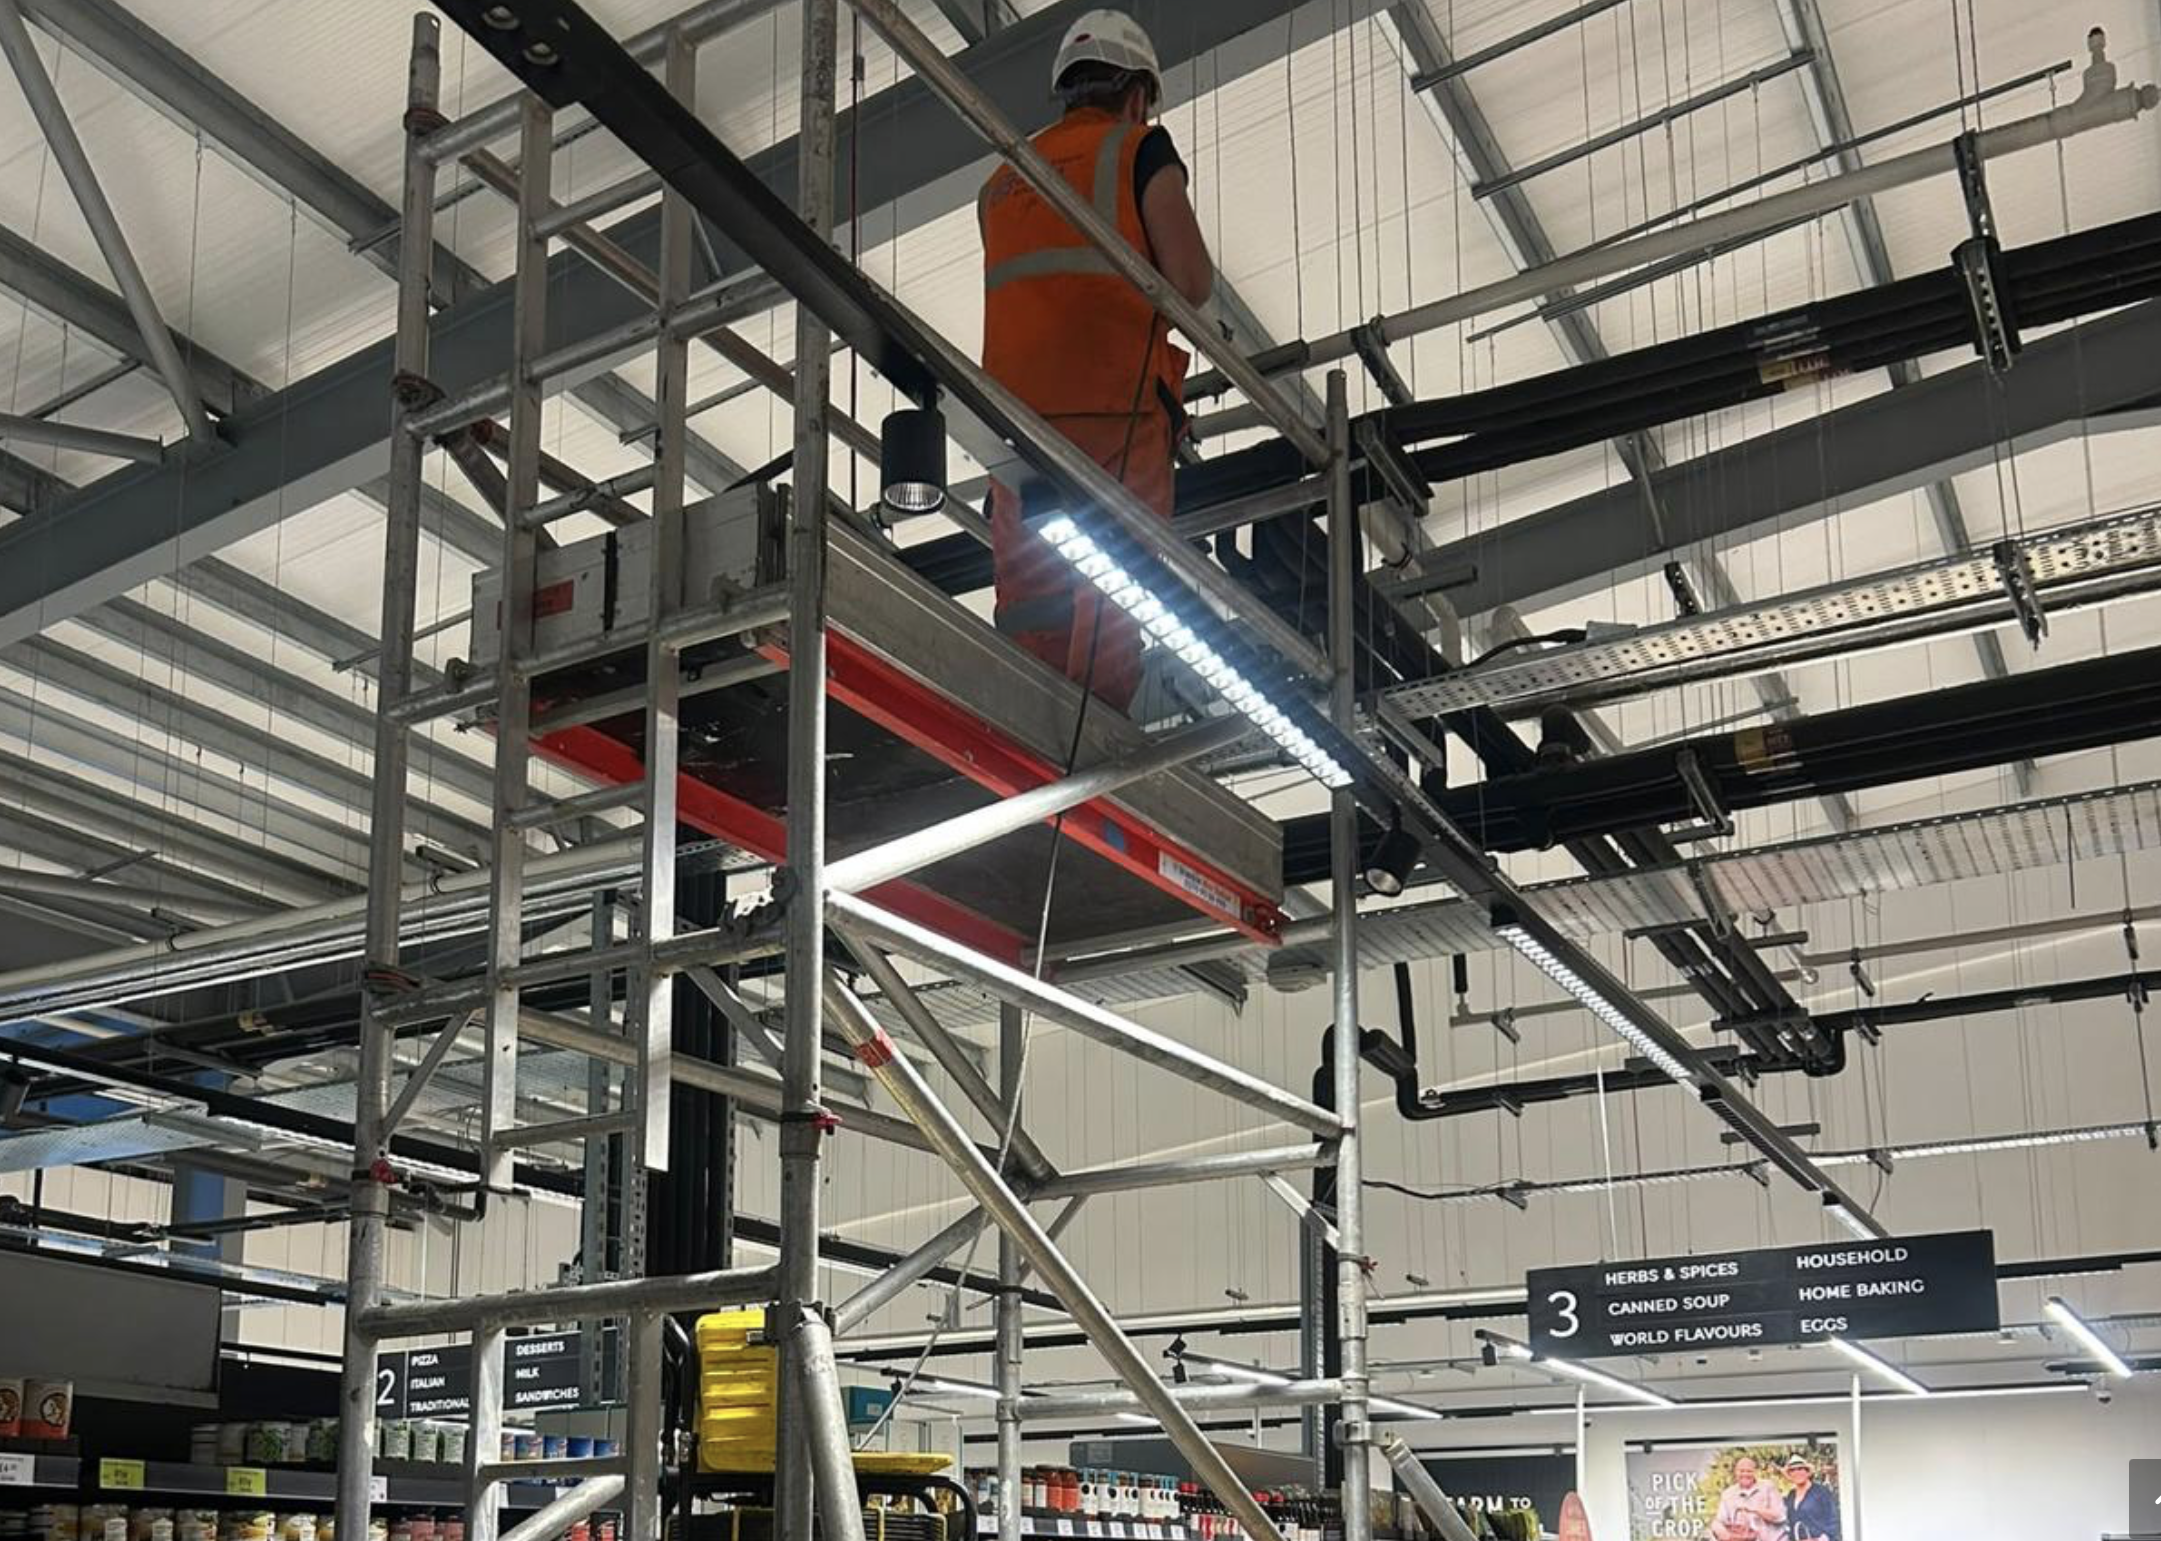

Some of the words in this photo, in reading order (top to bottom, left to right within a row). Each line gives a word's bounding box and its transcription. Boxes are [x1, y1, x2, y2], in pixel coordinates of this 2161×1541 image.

[1796, 1247, 1909, 1269] HOUSEHOLD
[1605, 1268, 1660, 1286] HERBS
[1663, 1267, 1676, 1281] &
[1679, 1261, 1739, 1280] SPICES
[1798, 1284, 1851, 1301] HOME
[1856, 1278, 1925, 1298] BAKING
[1547, 1290, 1579, 1338] 3
[1607, 1298, 1678, 1316] CANNED
[1682, 1293, 1731, 1311] SOUP
[1801, 1316, 1848, 1333] EGGS
[1609, 1330, 1669, 1347] WORLD
[1674, 1323, 1763, 1343] FLAVOURS
[516, 1341, 565, 1356] DESSERTS
[411, 1353, 439, 1367] PIZZA
[410, 1376, 445, 1389] ITALIAN
[515, 1367, 540, 1379] MILK
[377, 1368, 396, 1406] 2
[515, 1387, 579, 1403] SANDWICHES
[410, 1398, 470, 1412] TRADITIONAL
[1652, 1472, 1698, 1492] PICK
[1509, 1496, 1533, 1511] TO
[1645, 1496, 1663, 1510] OF
[1668, 1495, 1706, 1516] THE
[1652, 1518, 1705, 1538] CROP
